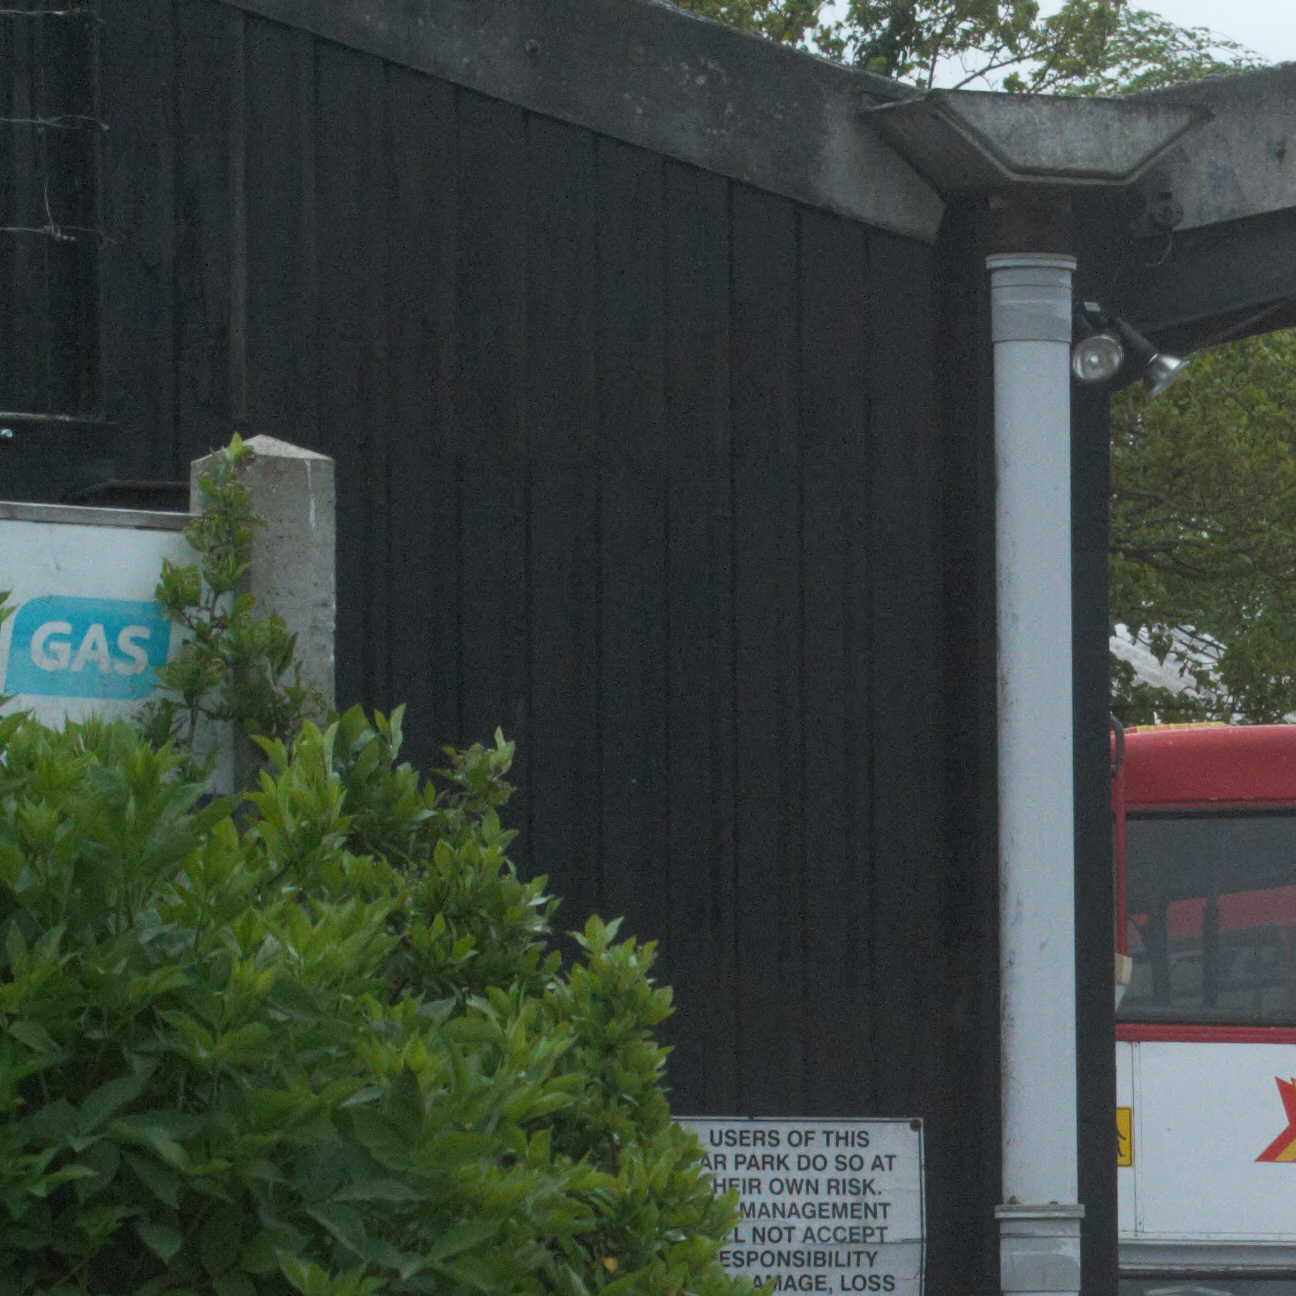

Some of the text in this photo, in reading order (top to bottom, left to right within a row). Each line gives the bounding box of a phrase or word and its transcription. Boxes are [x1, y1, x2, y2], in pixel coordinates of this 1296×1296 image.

[30, 621, 149, 675] GAS
[710, 1129, 870, 1148] USERS OF THIS
[700, 1154, 897, 1171] AR PARK DO SO AT
[713, 1178, 882, 1196] HEIR OWN RISK.
[739, 1202, 891, 1219] MANAGEMENT
[752, 1226, 796, 1244] NOT
[802, 1226, 889, 1244] ACCEPT
[719, 1251, 878, 1268] ESPONSIBILITY
[841, 1275, 896, 1292] LOSS
